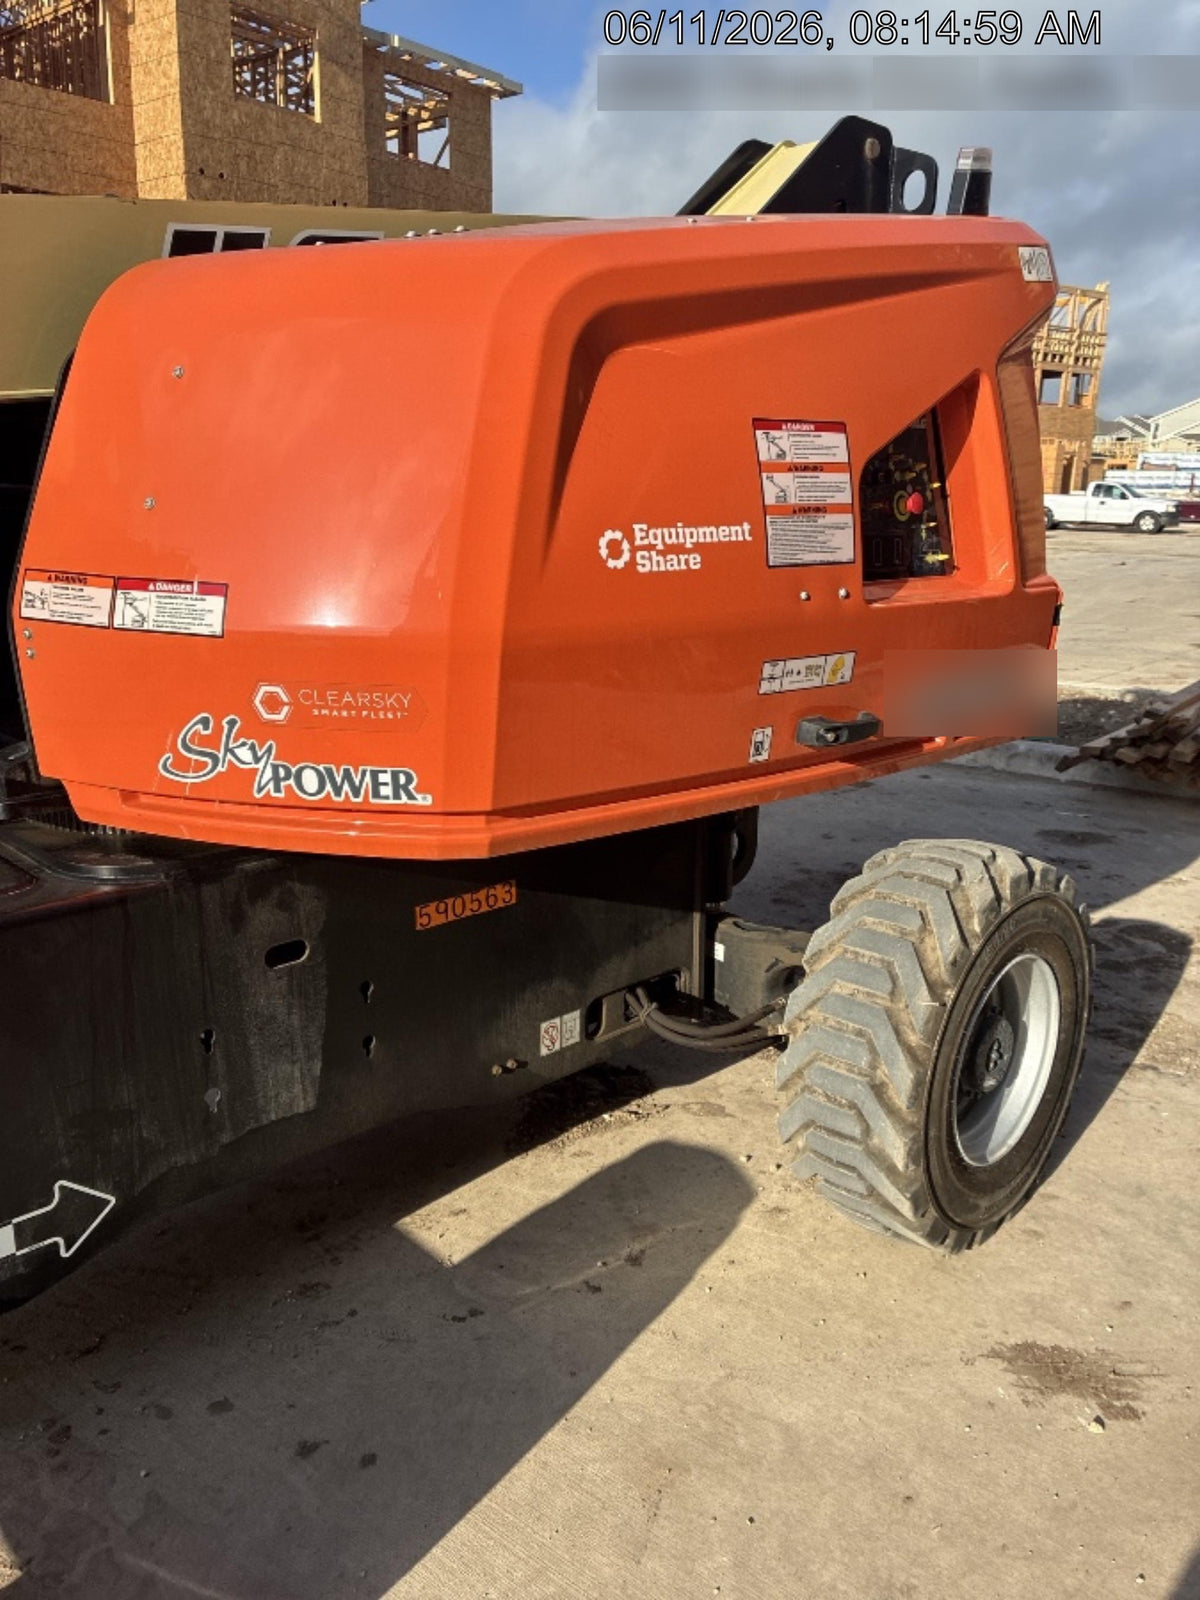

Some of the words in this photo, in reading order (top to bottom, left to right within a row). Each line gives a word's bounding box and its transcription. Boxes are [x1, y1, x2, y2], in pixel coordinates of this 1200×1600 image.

[632, 522, 752, 550] Equipment
[635, 551, 702, 573] Share
[155, 583, 193, 592] DANGER
[298, 689, 411, 708] CLEARSKY
[312, 708, 357, 718] SMART
[418, 881, 514, 928] 590563
